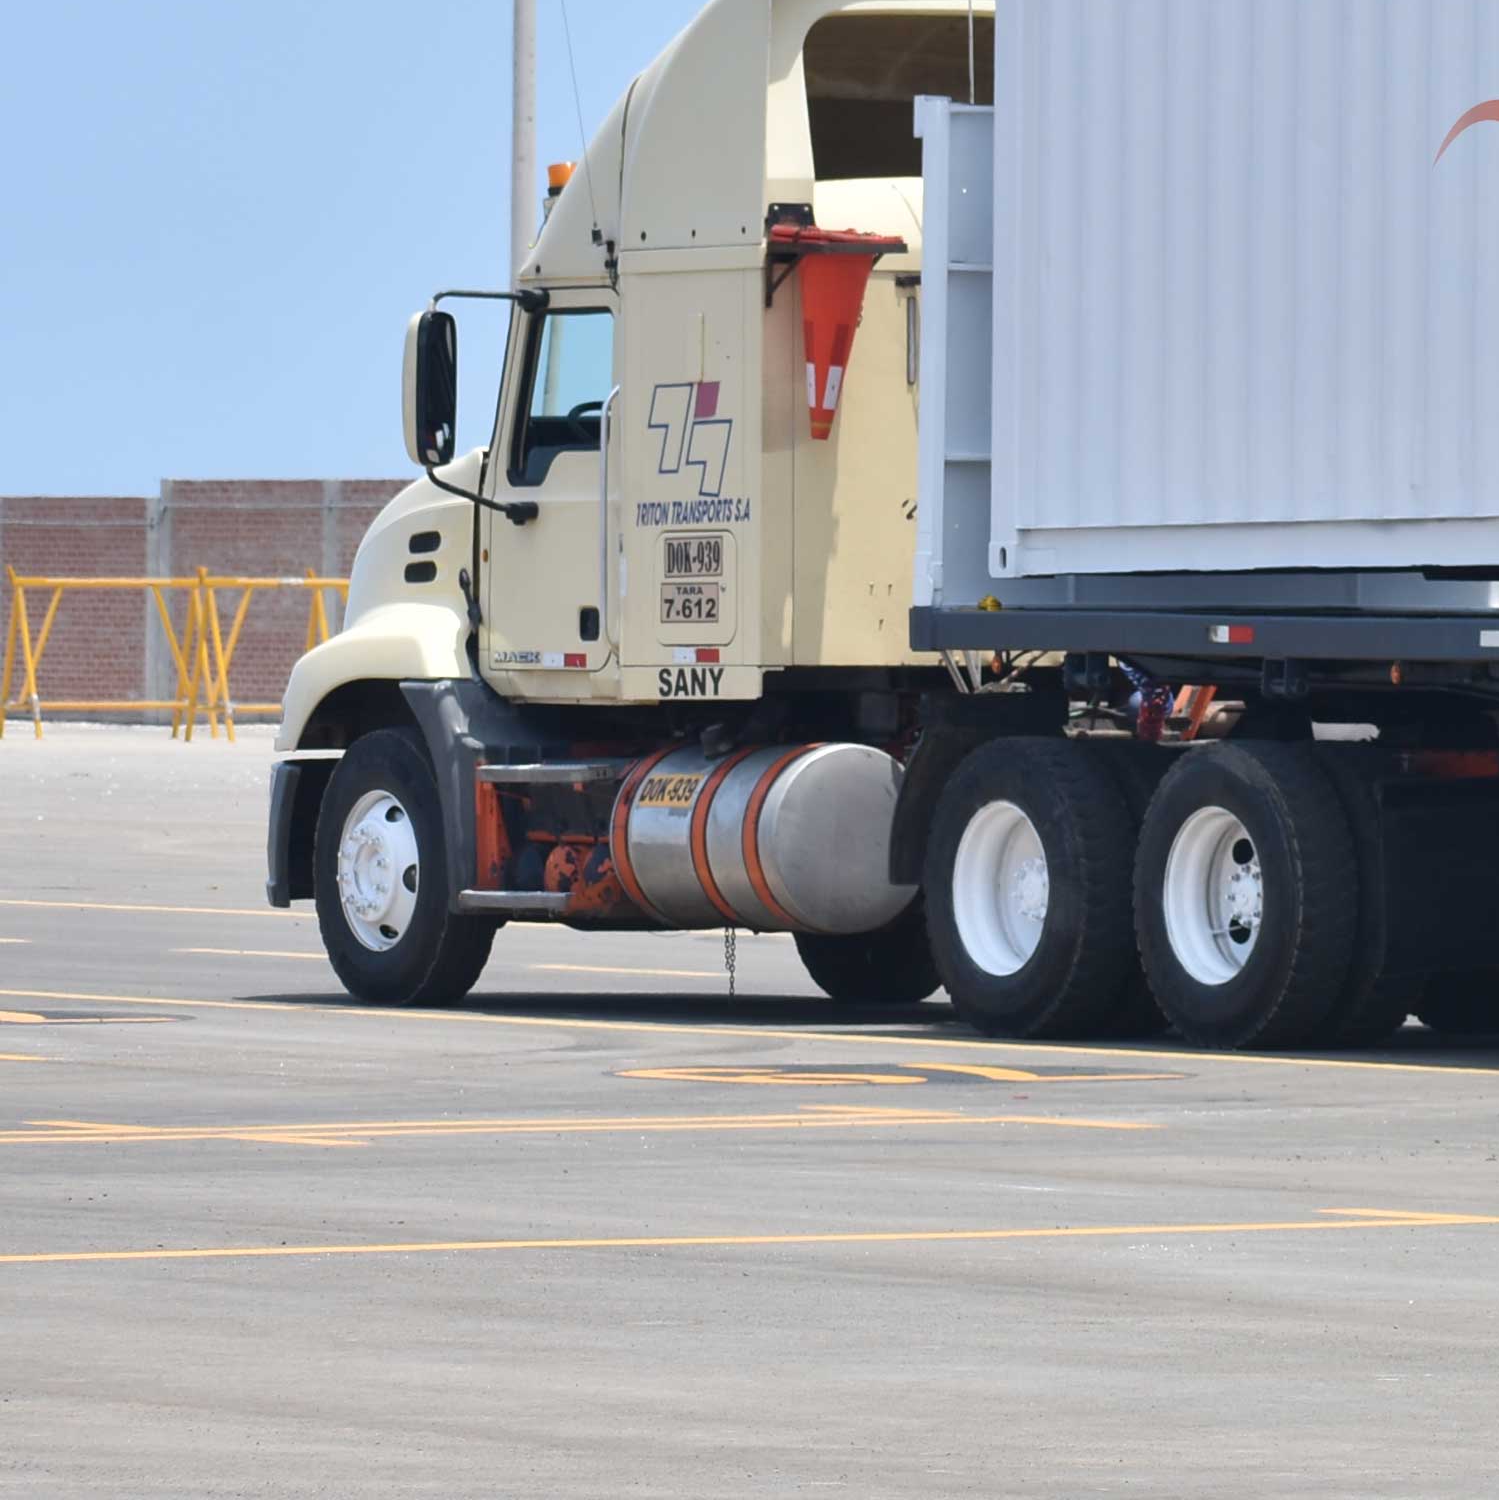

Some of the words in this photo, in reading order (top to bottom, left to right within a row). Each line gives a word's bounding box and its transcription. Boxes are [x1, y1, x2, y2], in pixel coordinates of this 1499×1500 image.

[636, 501, 670, 527] TRITON
[671, 498, 733, 524] TRANSPORTS
[667, 540, 720, 573] DOK-939
[675, 586, 704, 596] TARA
[663, 598, 717, 619] 7.612
[658, 667, 725, 697] SANY
[639, 777, 700, 802] DOK-939
